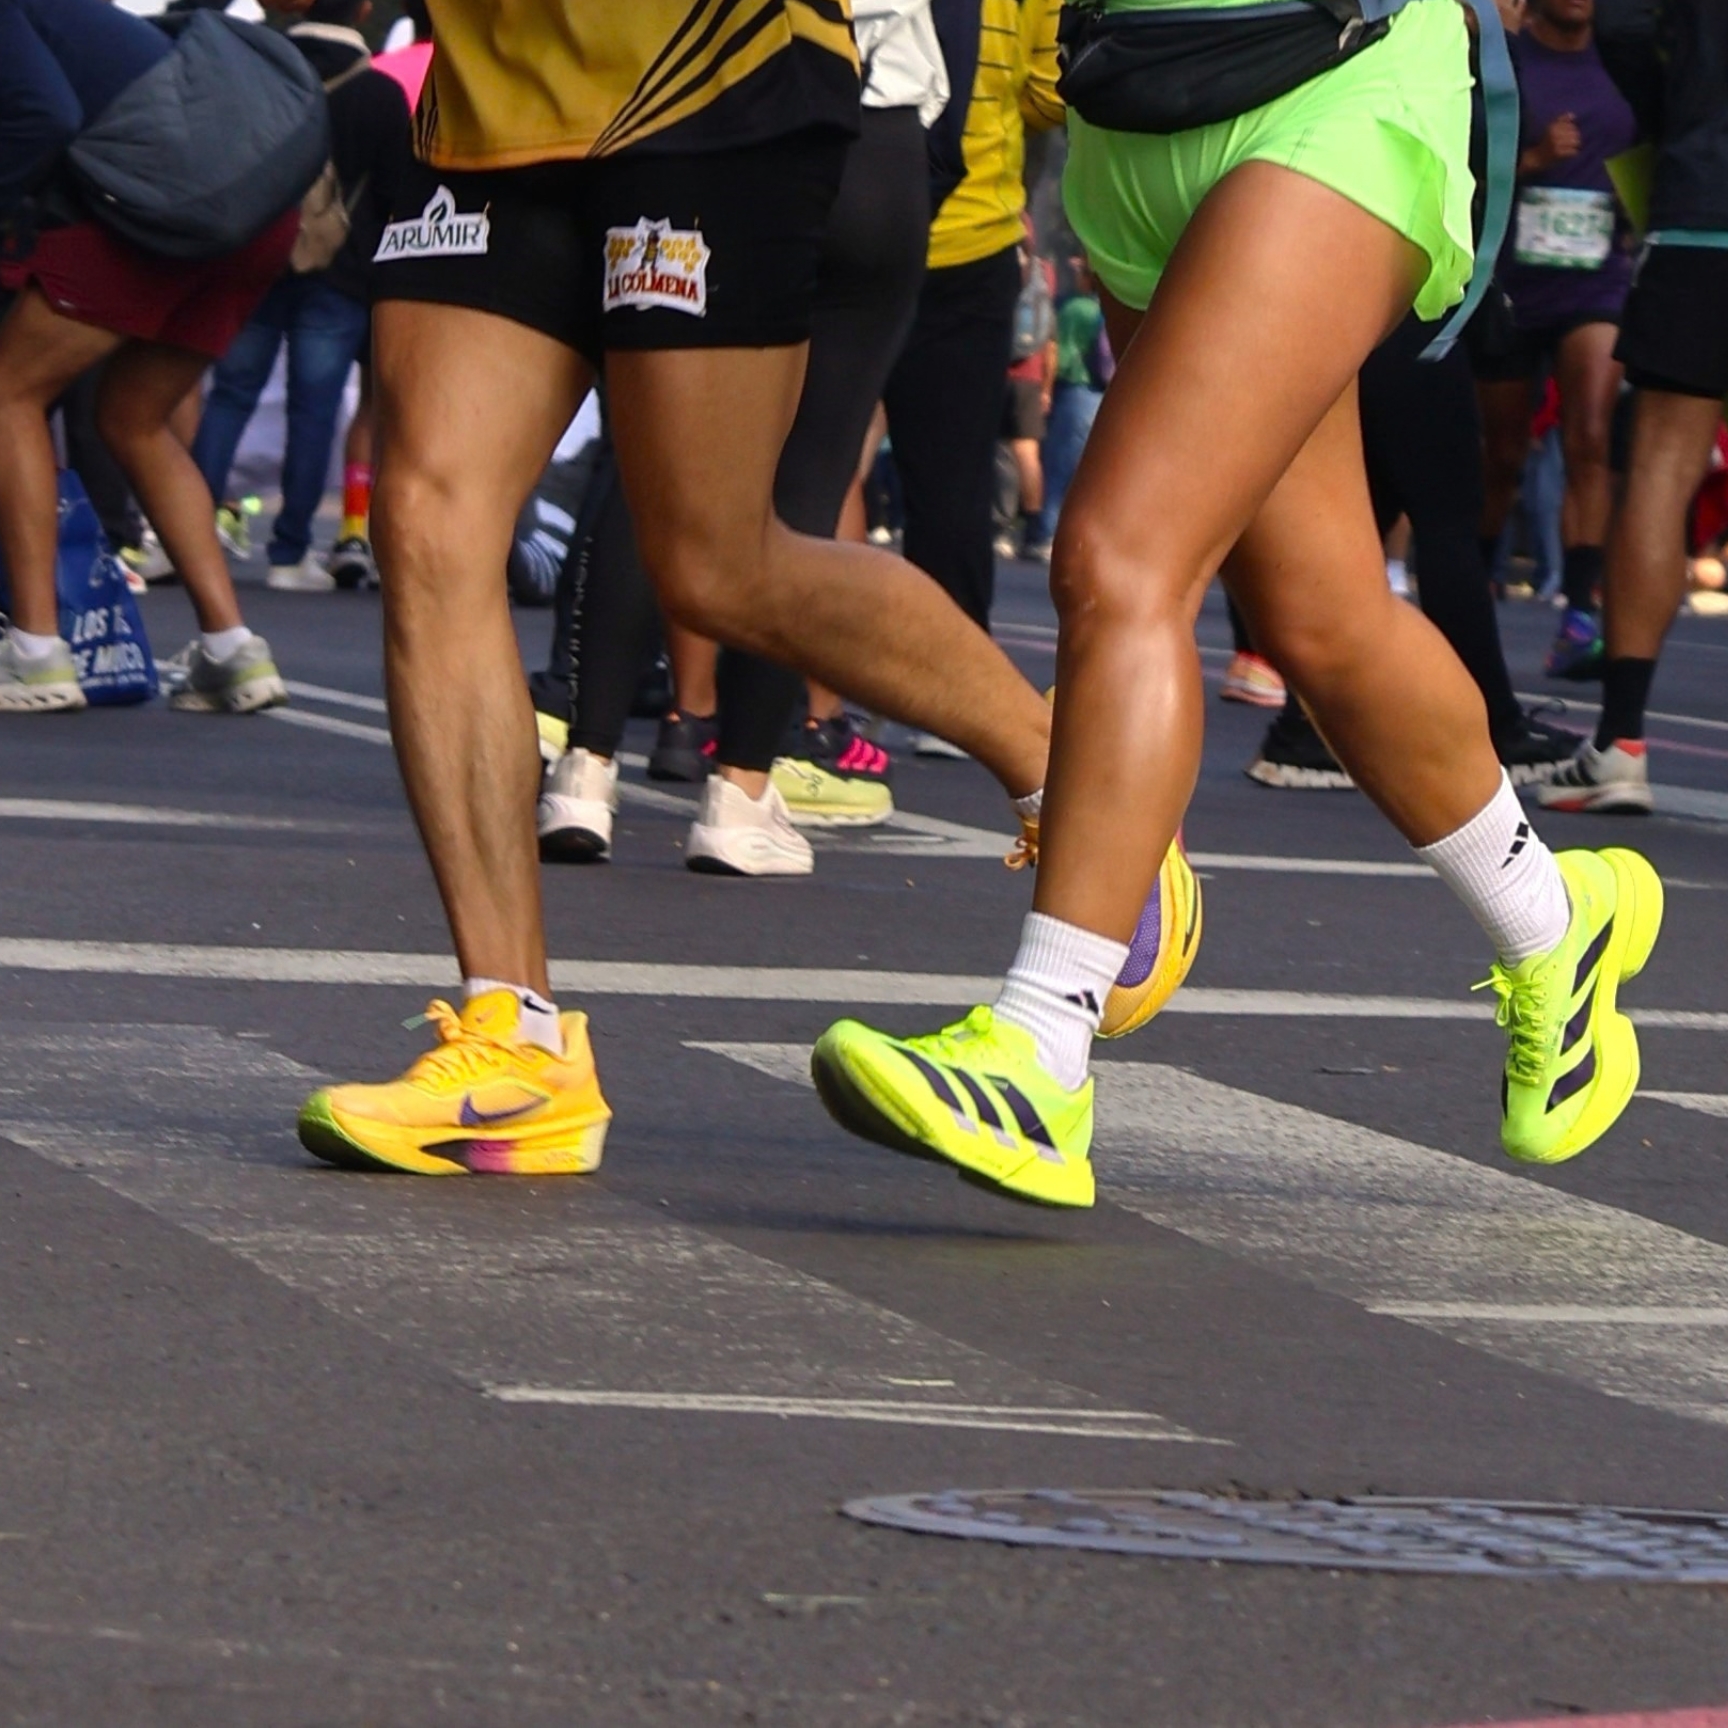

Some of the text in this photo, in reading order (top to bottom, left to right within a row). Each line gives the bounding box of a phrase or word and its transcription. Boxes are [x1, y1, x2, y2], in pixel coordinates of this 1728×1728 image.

[383, 223, 481, 253] ARUMIR
[608, 270, 698, 302] LA COLMENA
